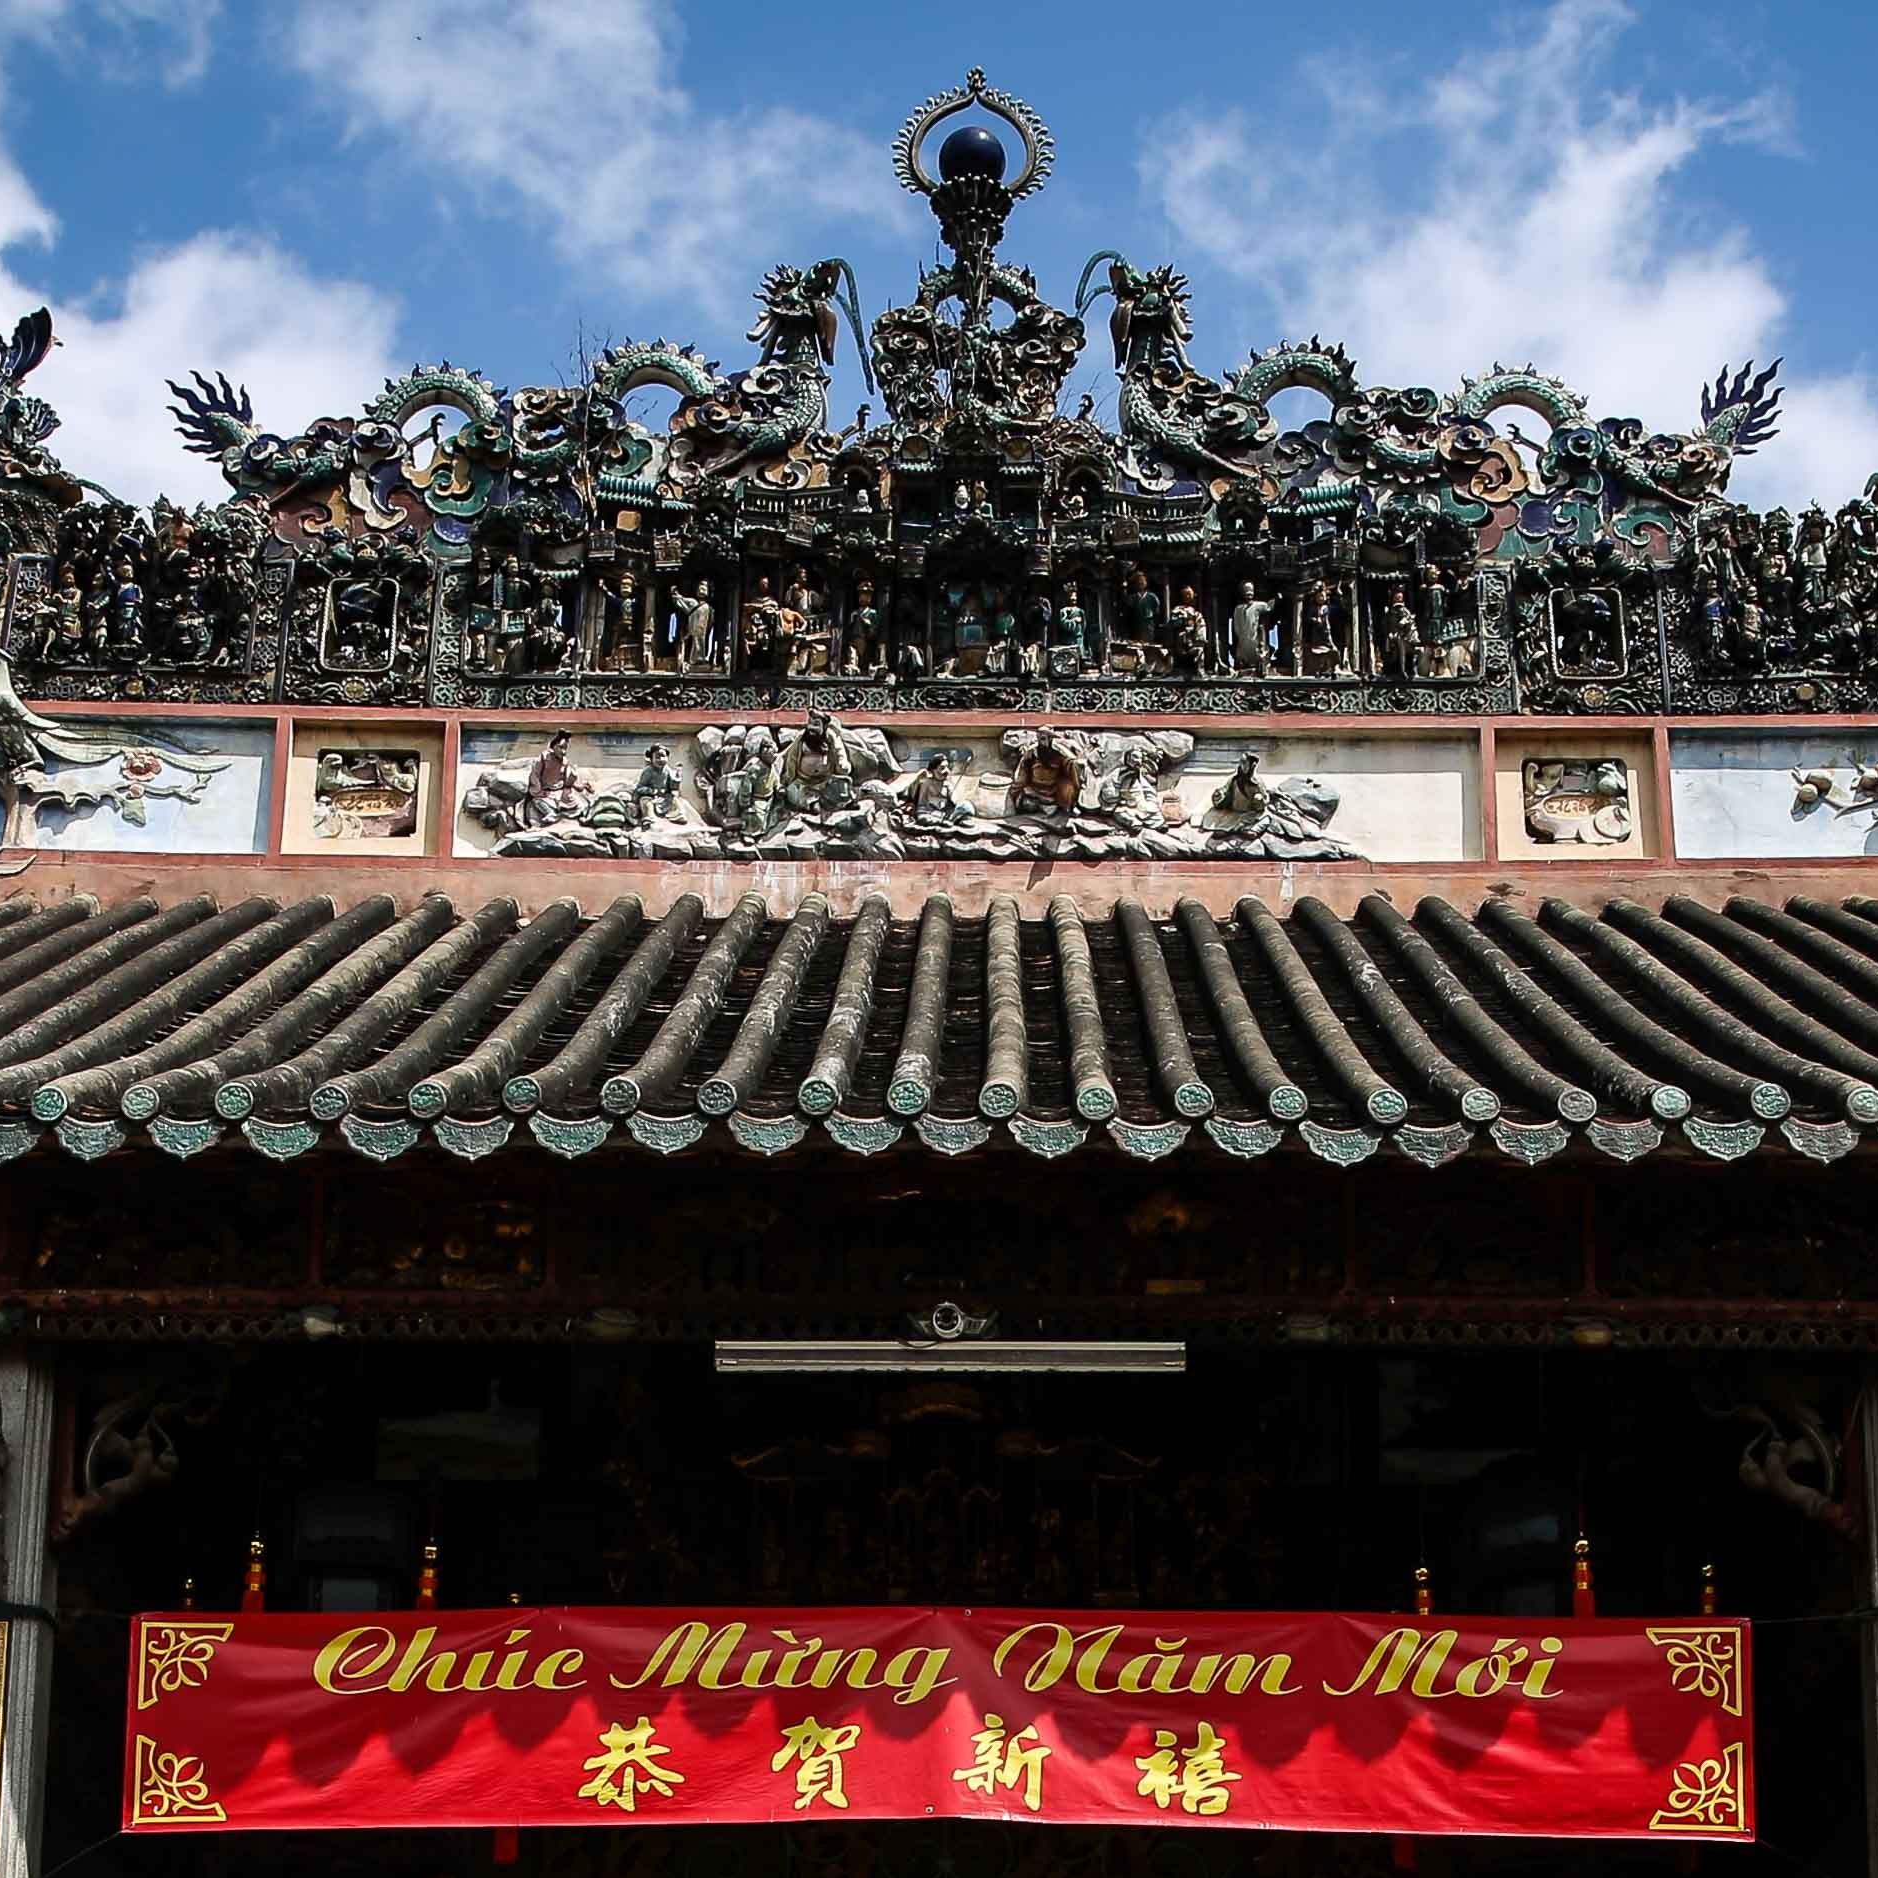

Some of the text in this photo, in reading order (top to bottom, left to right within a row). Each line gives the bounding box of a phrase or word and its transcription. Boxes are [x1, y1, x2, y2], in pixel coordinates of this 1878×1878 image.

[313, 1622, 1564, 1704] Chúc Mừng Năm Mới
[577, 1714, 1244, 1815] 恭賀新禧
